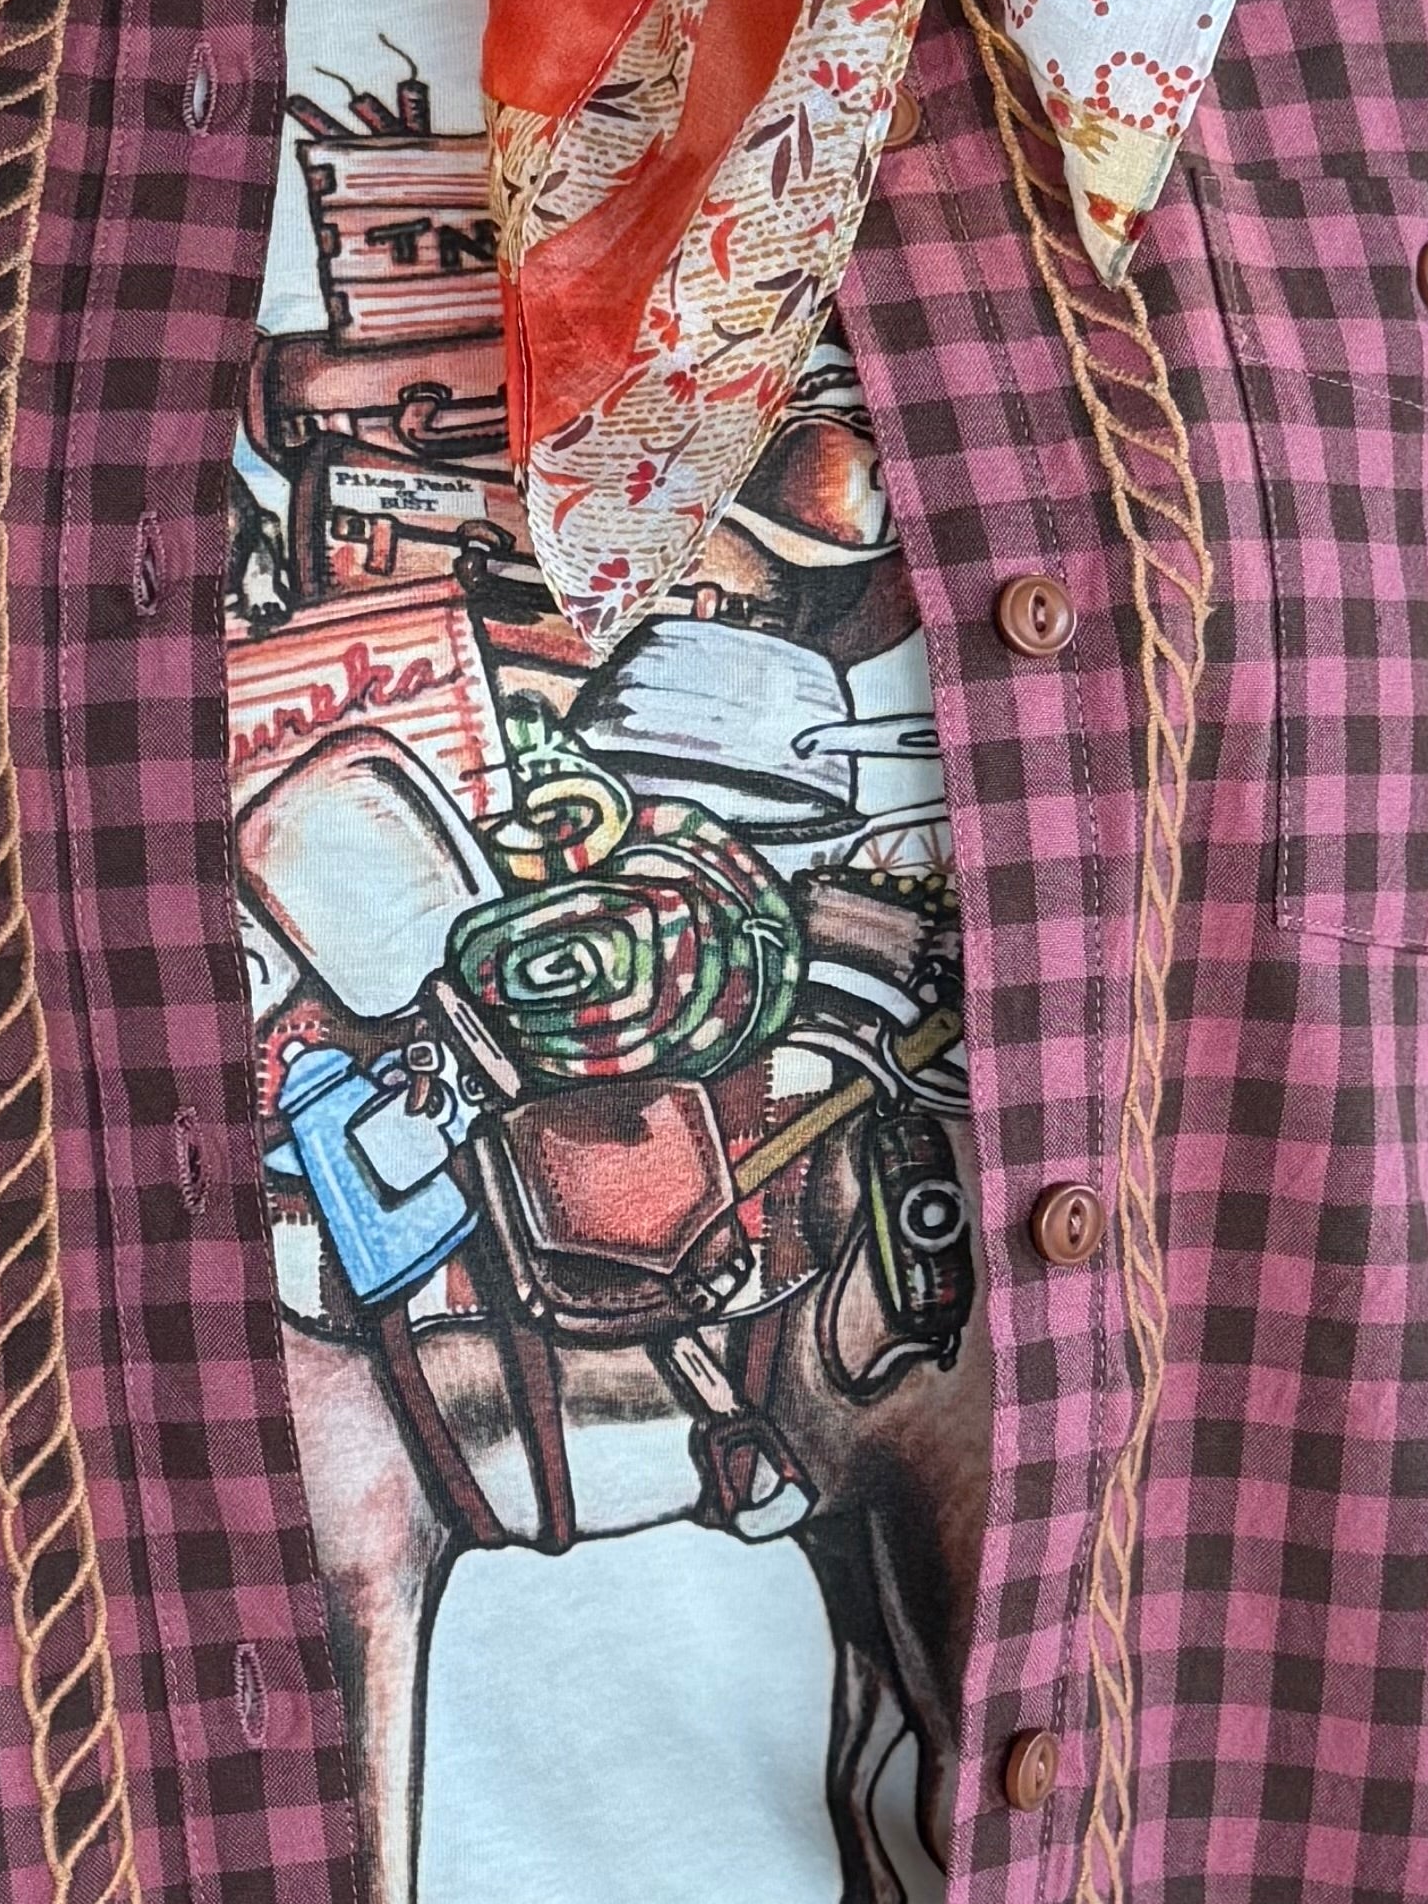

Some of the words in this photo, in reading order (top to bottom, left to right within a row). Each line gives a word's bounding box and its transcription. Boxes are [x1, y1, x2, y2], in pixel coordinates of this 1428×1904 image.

[365, 216, 502, 269] TN
[380, 496, 439, 512] BUST
[232, 642, 464, 768] ureka
